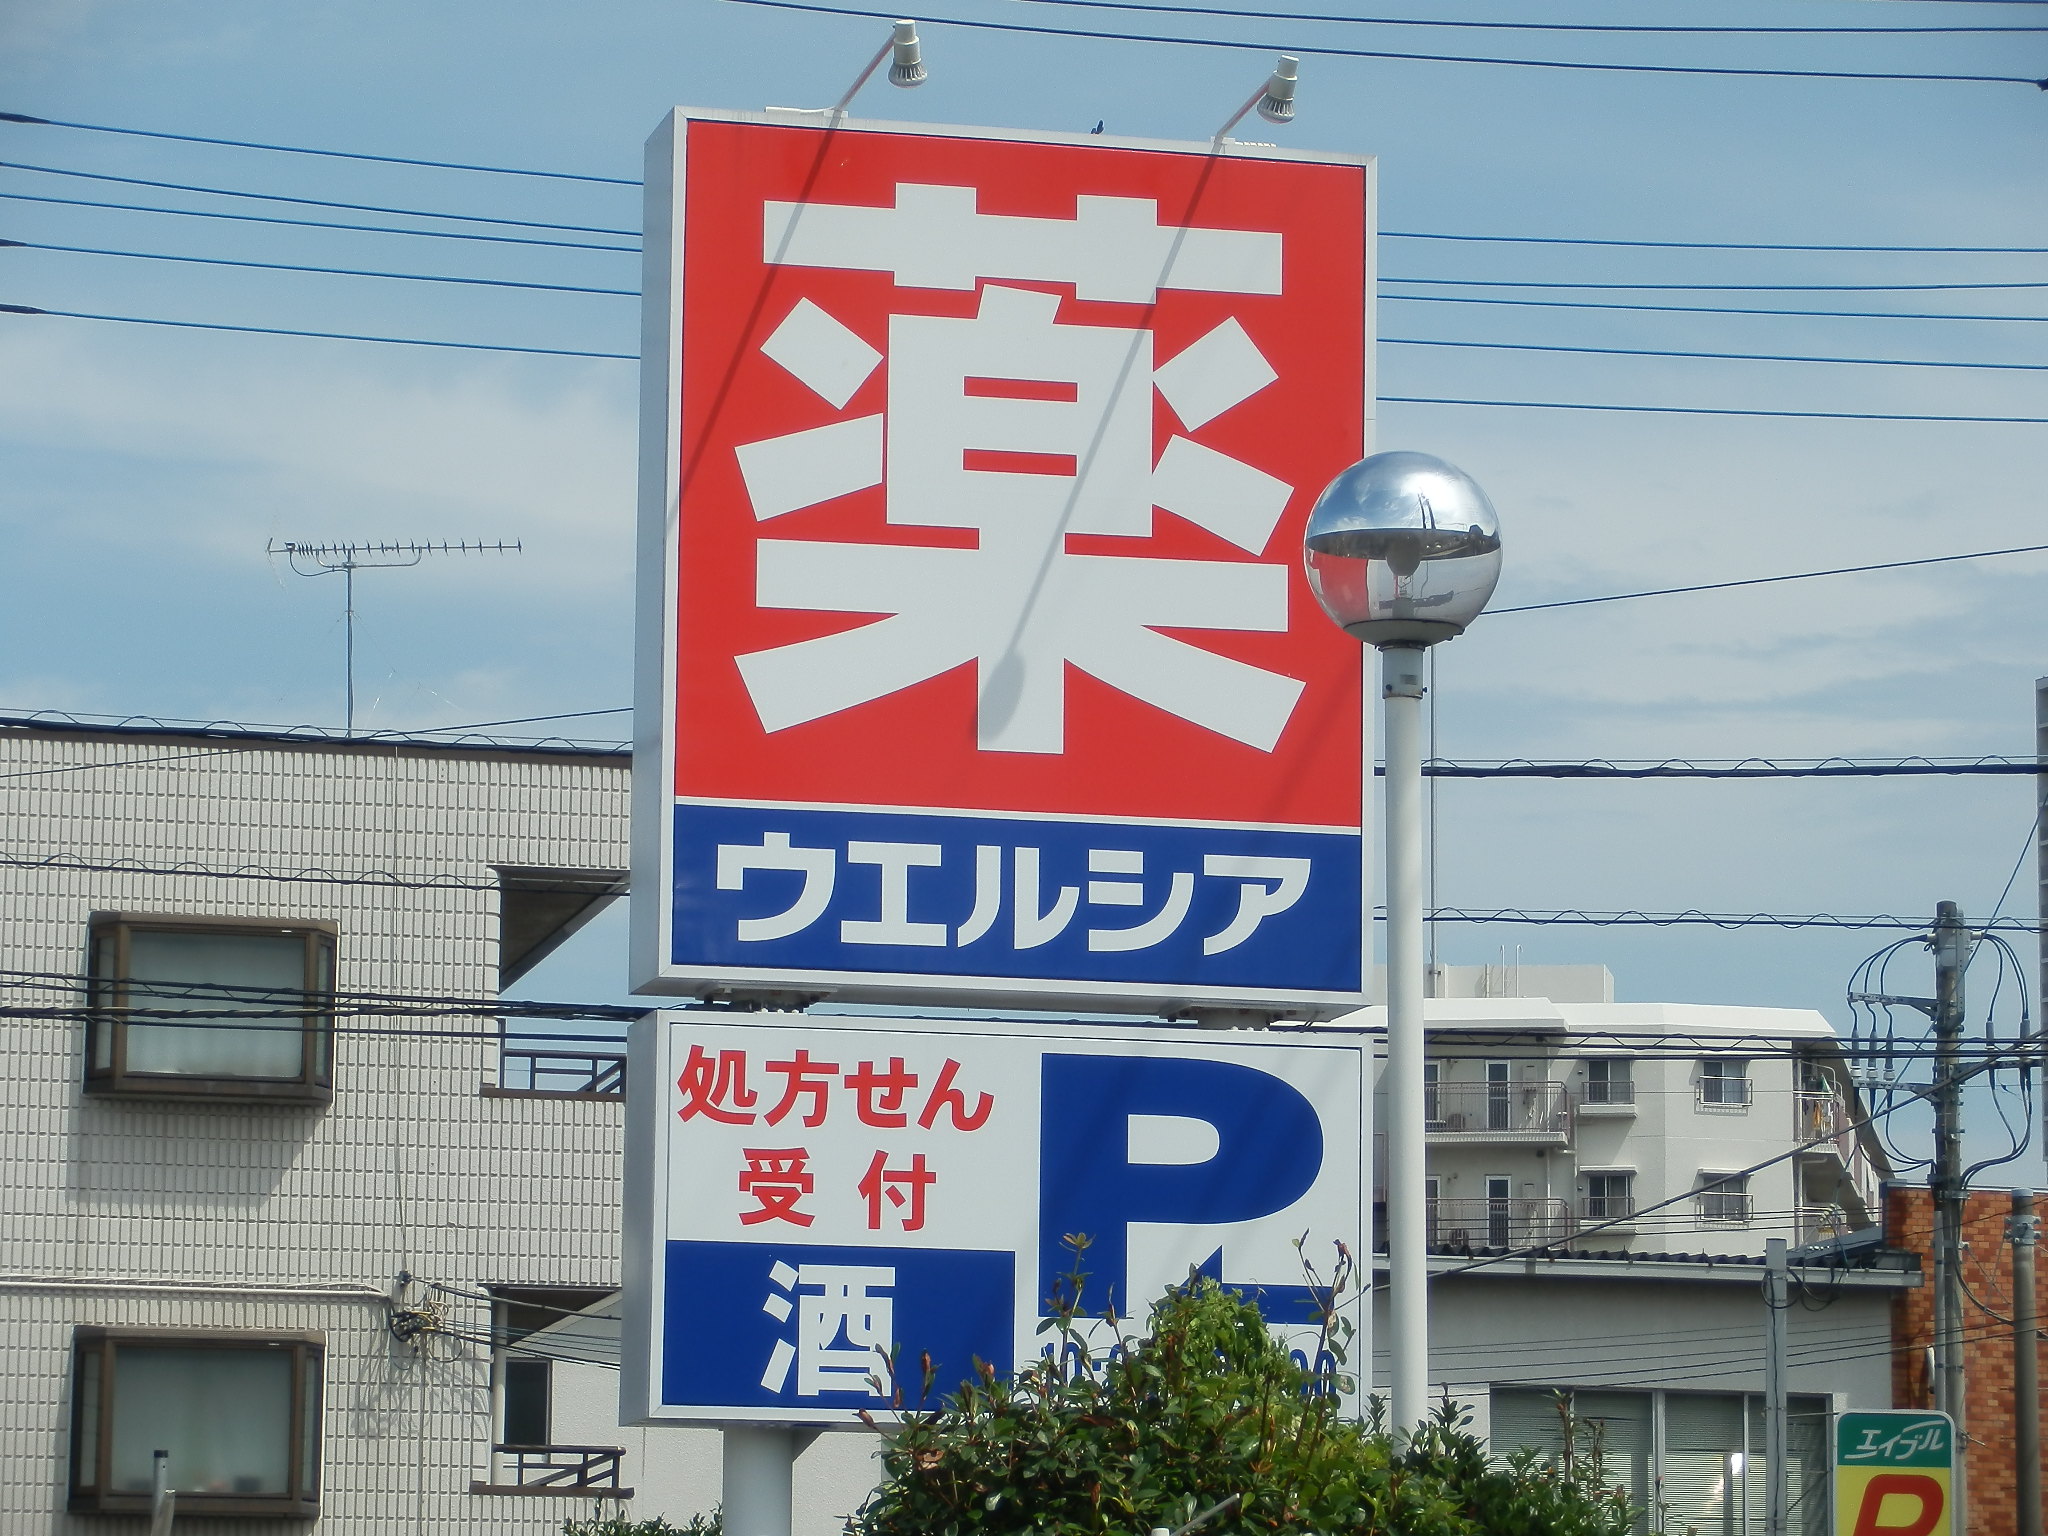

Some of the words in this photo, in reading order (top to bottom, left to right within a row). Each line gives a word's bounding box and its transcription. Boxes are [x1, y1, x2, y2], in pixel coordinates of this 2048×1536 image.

[734, 182, 1306, 755] 薬
[717, 832, 1311, 956] ウエルシア
[676, 1044, 995, 1132] 処方せん
[760, 1260, 897, 1398] 酒
[1847, 1421, 1945, 1460] エイブル
